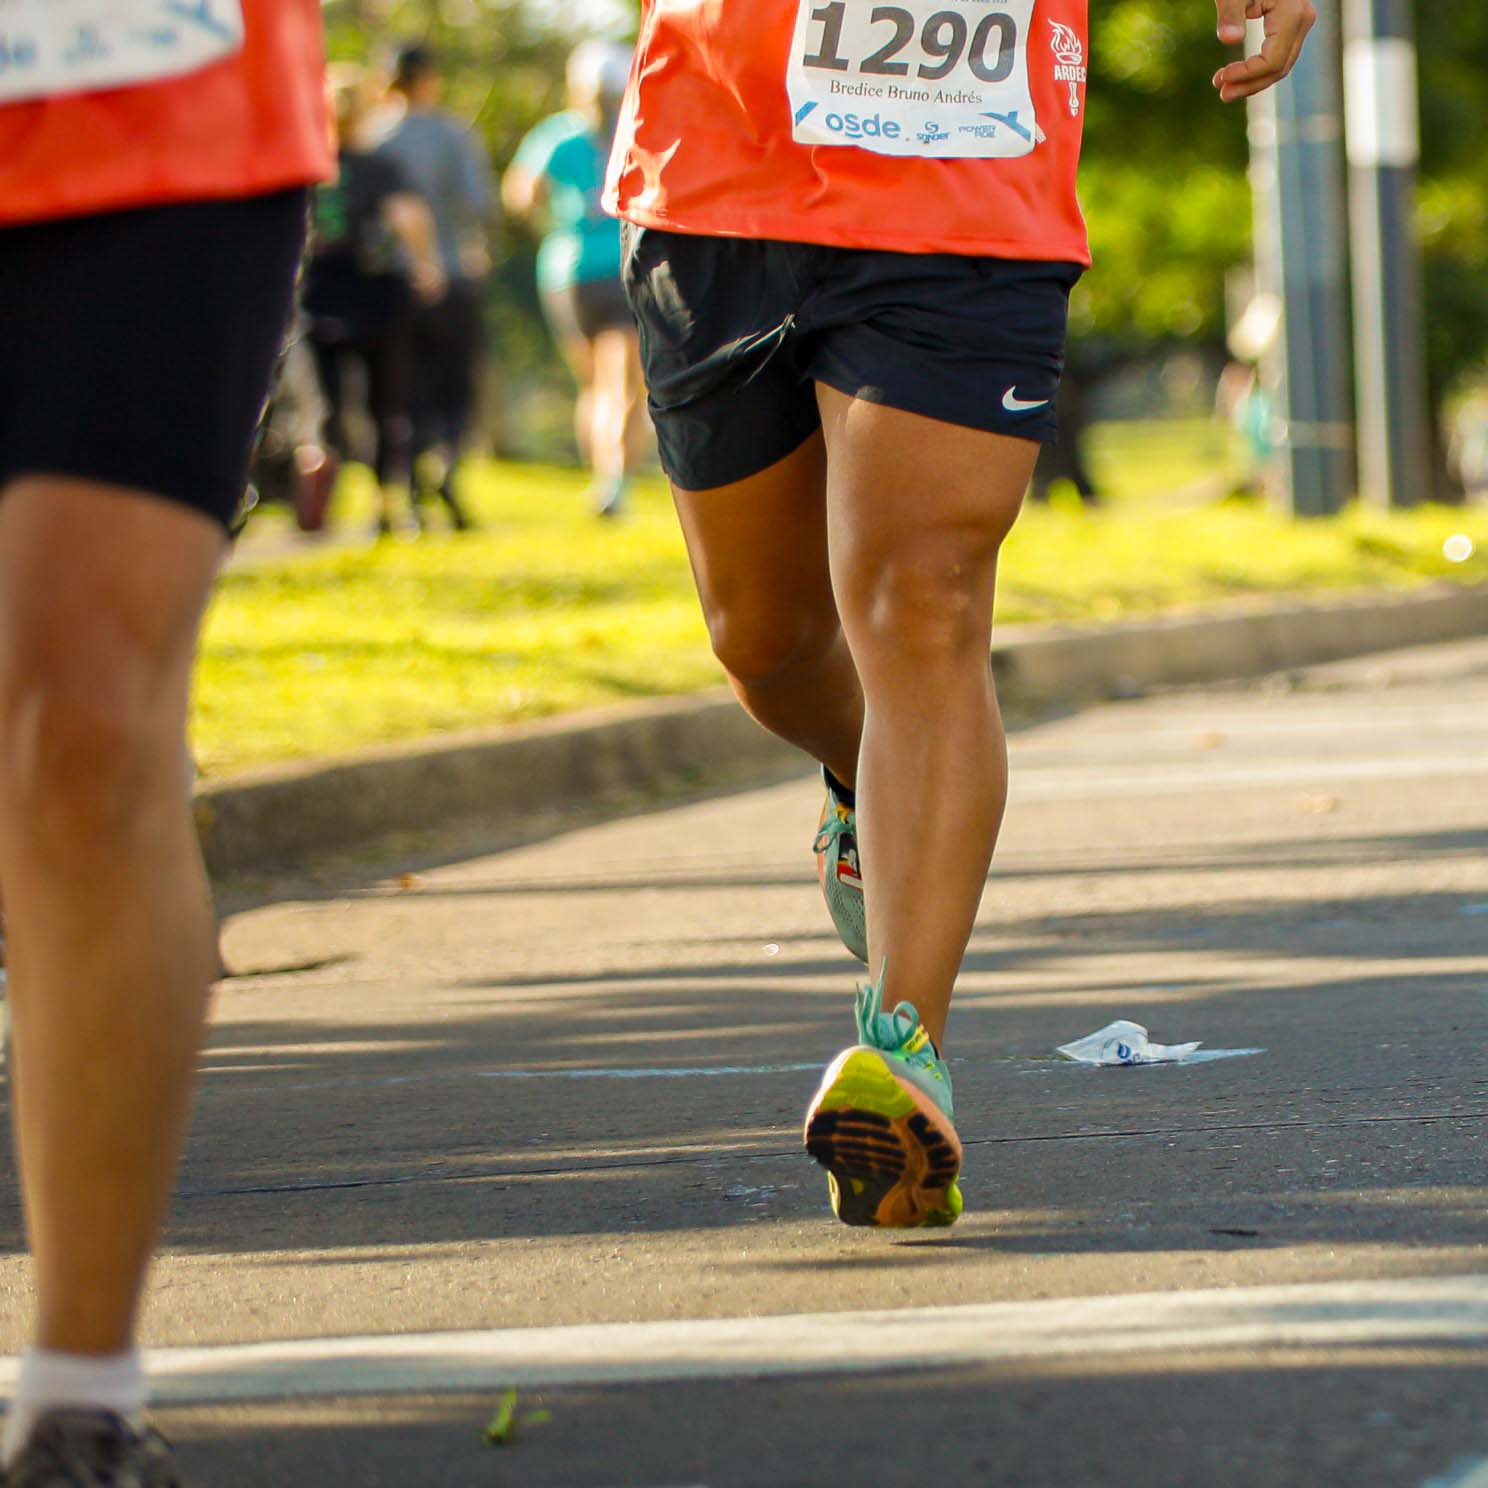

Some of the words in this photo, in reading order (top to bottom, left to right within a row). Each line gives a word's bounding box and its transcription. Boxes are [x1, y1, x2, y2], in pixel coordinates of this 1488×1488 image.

[803, 1, 1017, 83] 1290
[1054, 65, 1087, 83] ARDEC
[829, 79, 884, 98] Bredice
[887, 85, 930, 102] Bruno
[933, 87, 983, 105] Andrés
[825, 111, 901, 139] osde
